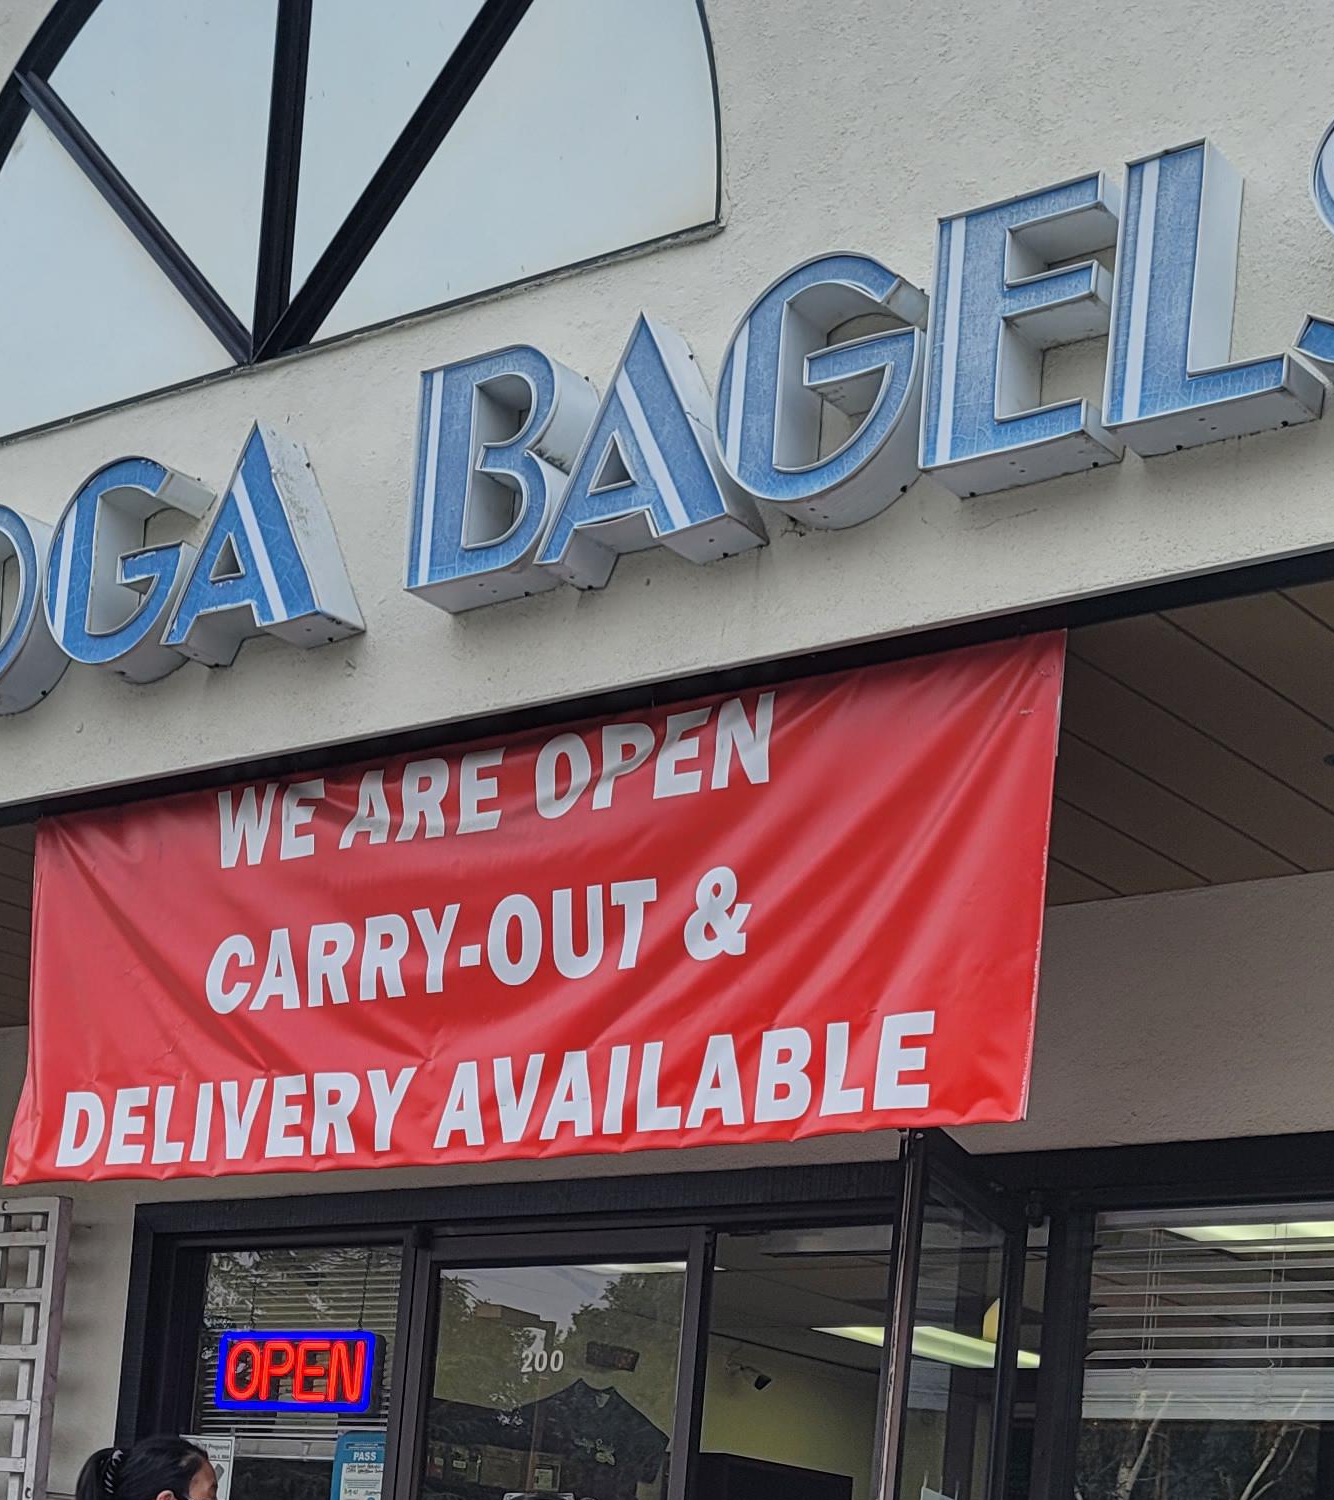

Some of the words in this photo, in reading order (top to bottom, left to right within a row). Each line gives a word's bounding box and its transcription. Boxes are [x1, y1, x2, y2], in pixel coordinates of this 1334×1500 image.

[217, 780, 325, 870] WE
[339, 748, 508, 850] ARE
[535, 691, 776, 821] OPEN
[205, 877, 658, 1016] CARRY-OUT
[683, 865, 753, 963] &
[54, 1066, 418, 1168] DELIVERY
[434, 1010, 936, 1150] AVAILABLE
[224, 1339, 367, 1404] OPEN
[520, 1350, 564, 1373] 200
[353, 1451, 377, 1462] PASS
